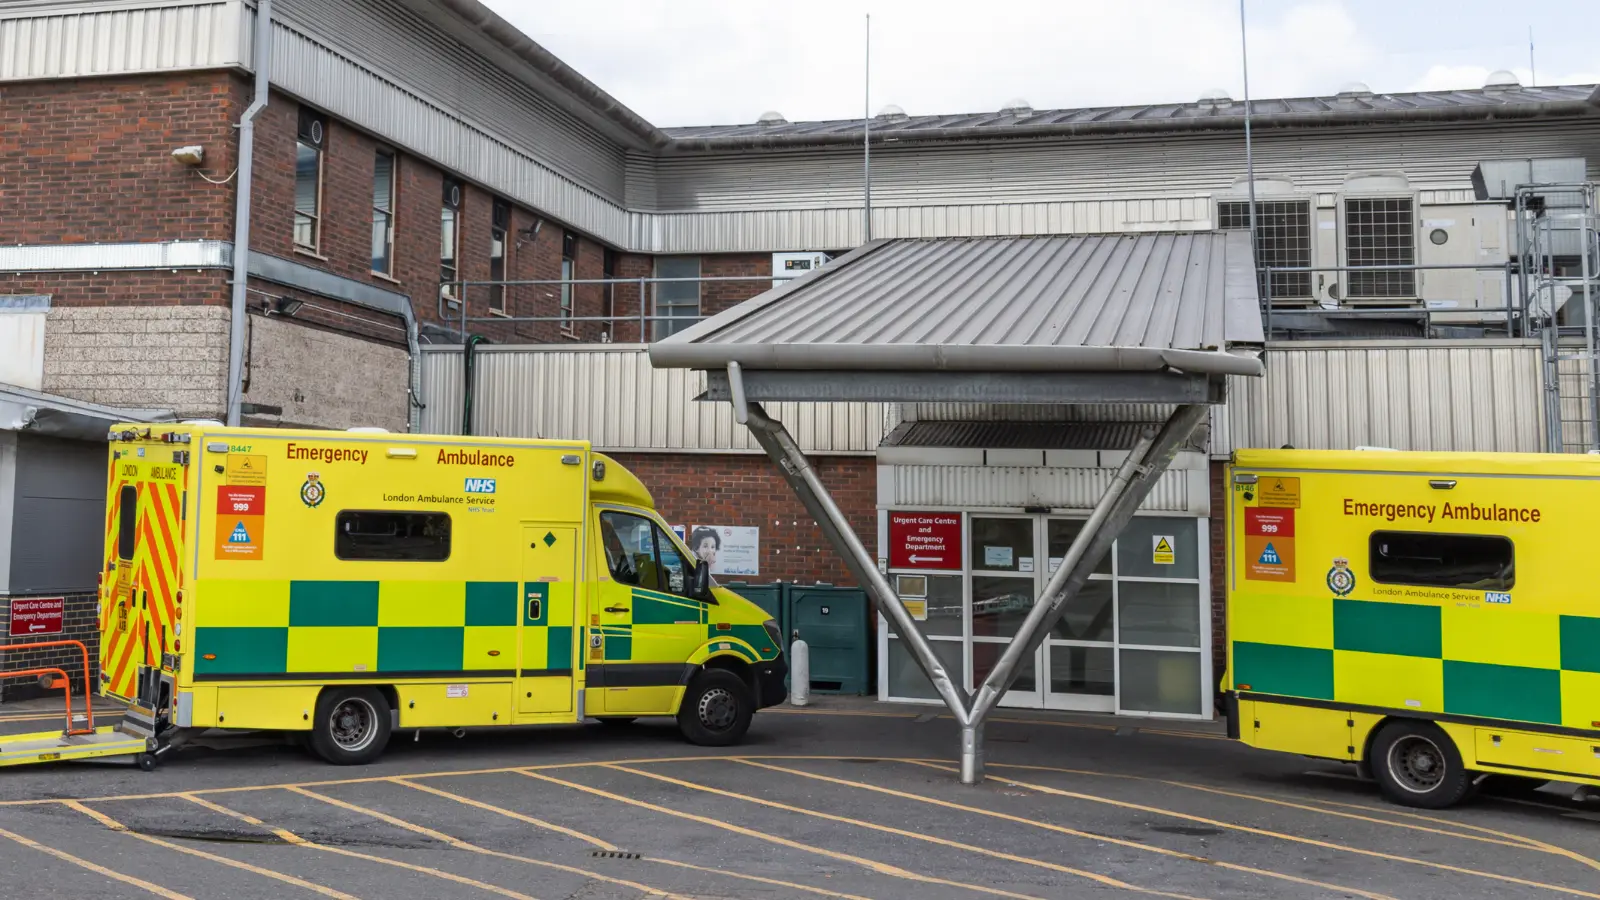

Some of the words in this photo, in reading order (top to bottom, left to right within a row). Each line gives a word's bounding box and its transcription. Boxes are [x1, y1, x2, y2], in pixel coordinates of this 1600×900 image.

[287, 443, 368, 465] Emergency
[437, 448, 515, 467] Ambulance
[465, 479, 495, 492] NHS
[383, 494, 415, 503] London
[417, 495, 464, 504] Ambulance
[466, 496, 495, 505] Service
[233, 503, 249, 511] 999
[1343, 498, 1436, 524] Emergency
[1441, 502, 1541, 523] Ambulance
[893, 516, 917, 525] Urgent
[934, 517, 957, 525] Centre
[1261, 524, 1278, 533] 999
[232, 533, 247, 541] 111
[906, 535, 944, 544] Emergency
[905, 543, 946, 551] Department
[1262, 554, 1277, 562] 111
[1372, 587, 1403, 597] London
[1404, 589, 1450, 600] Ambulance
[1451, 591, 1480, 602] Service
[1485, 593, 1510, 604] NHS
[13, 602, 29, 611] Urgent
[39, 601, 53, 609] Centre
[53, 600, 62, 608] and
[13, 613, 36, 621] Emergency
[36, 612, 62, 620] Department
